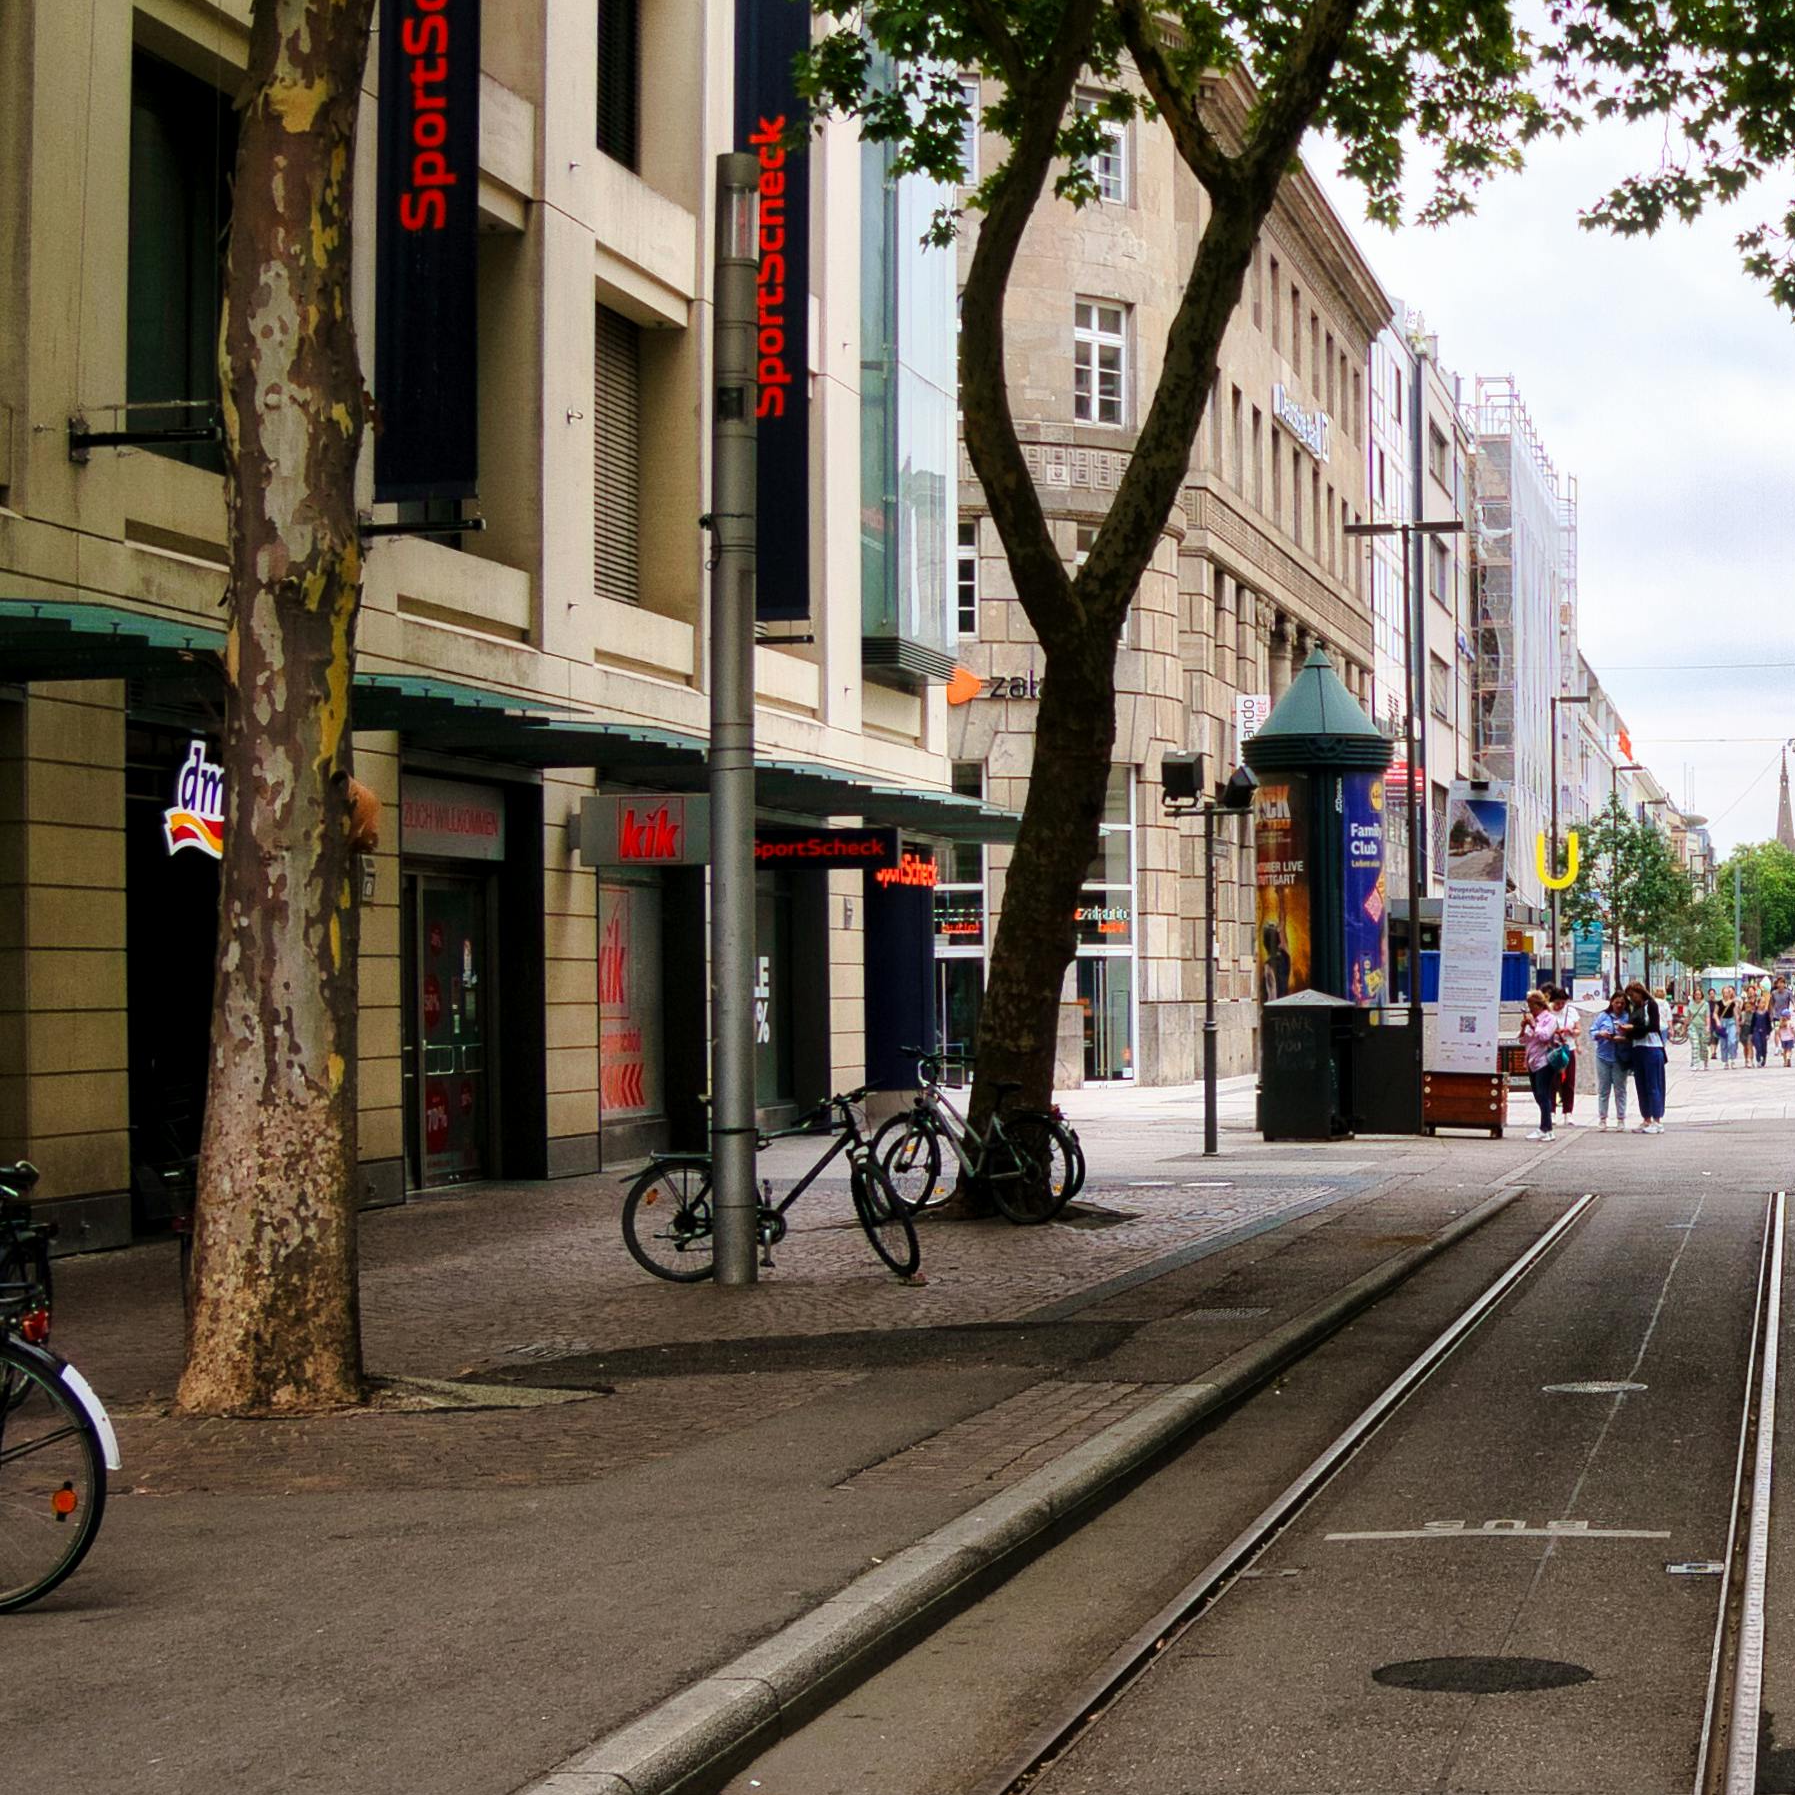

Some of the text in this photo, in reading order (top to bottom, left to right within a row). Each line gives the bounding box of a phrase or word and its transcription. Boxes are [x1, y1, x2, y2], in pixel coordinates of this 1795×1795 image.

[1241, 699, 1255, 740] ando
[181, 746, 224, 814] dm
[403, 801, 431, 829] ZLICH
[1350, 822, 1382, 840] Family
[753, 838, 885, 858] SportScheck
[1350, 840, 1378, 855] Club
[1283, 860, 1304, 873] LIVE
[1536, 831, 1579, 890] U
